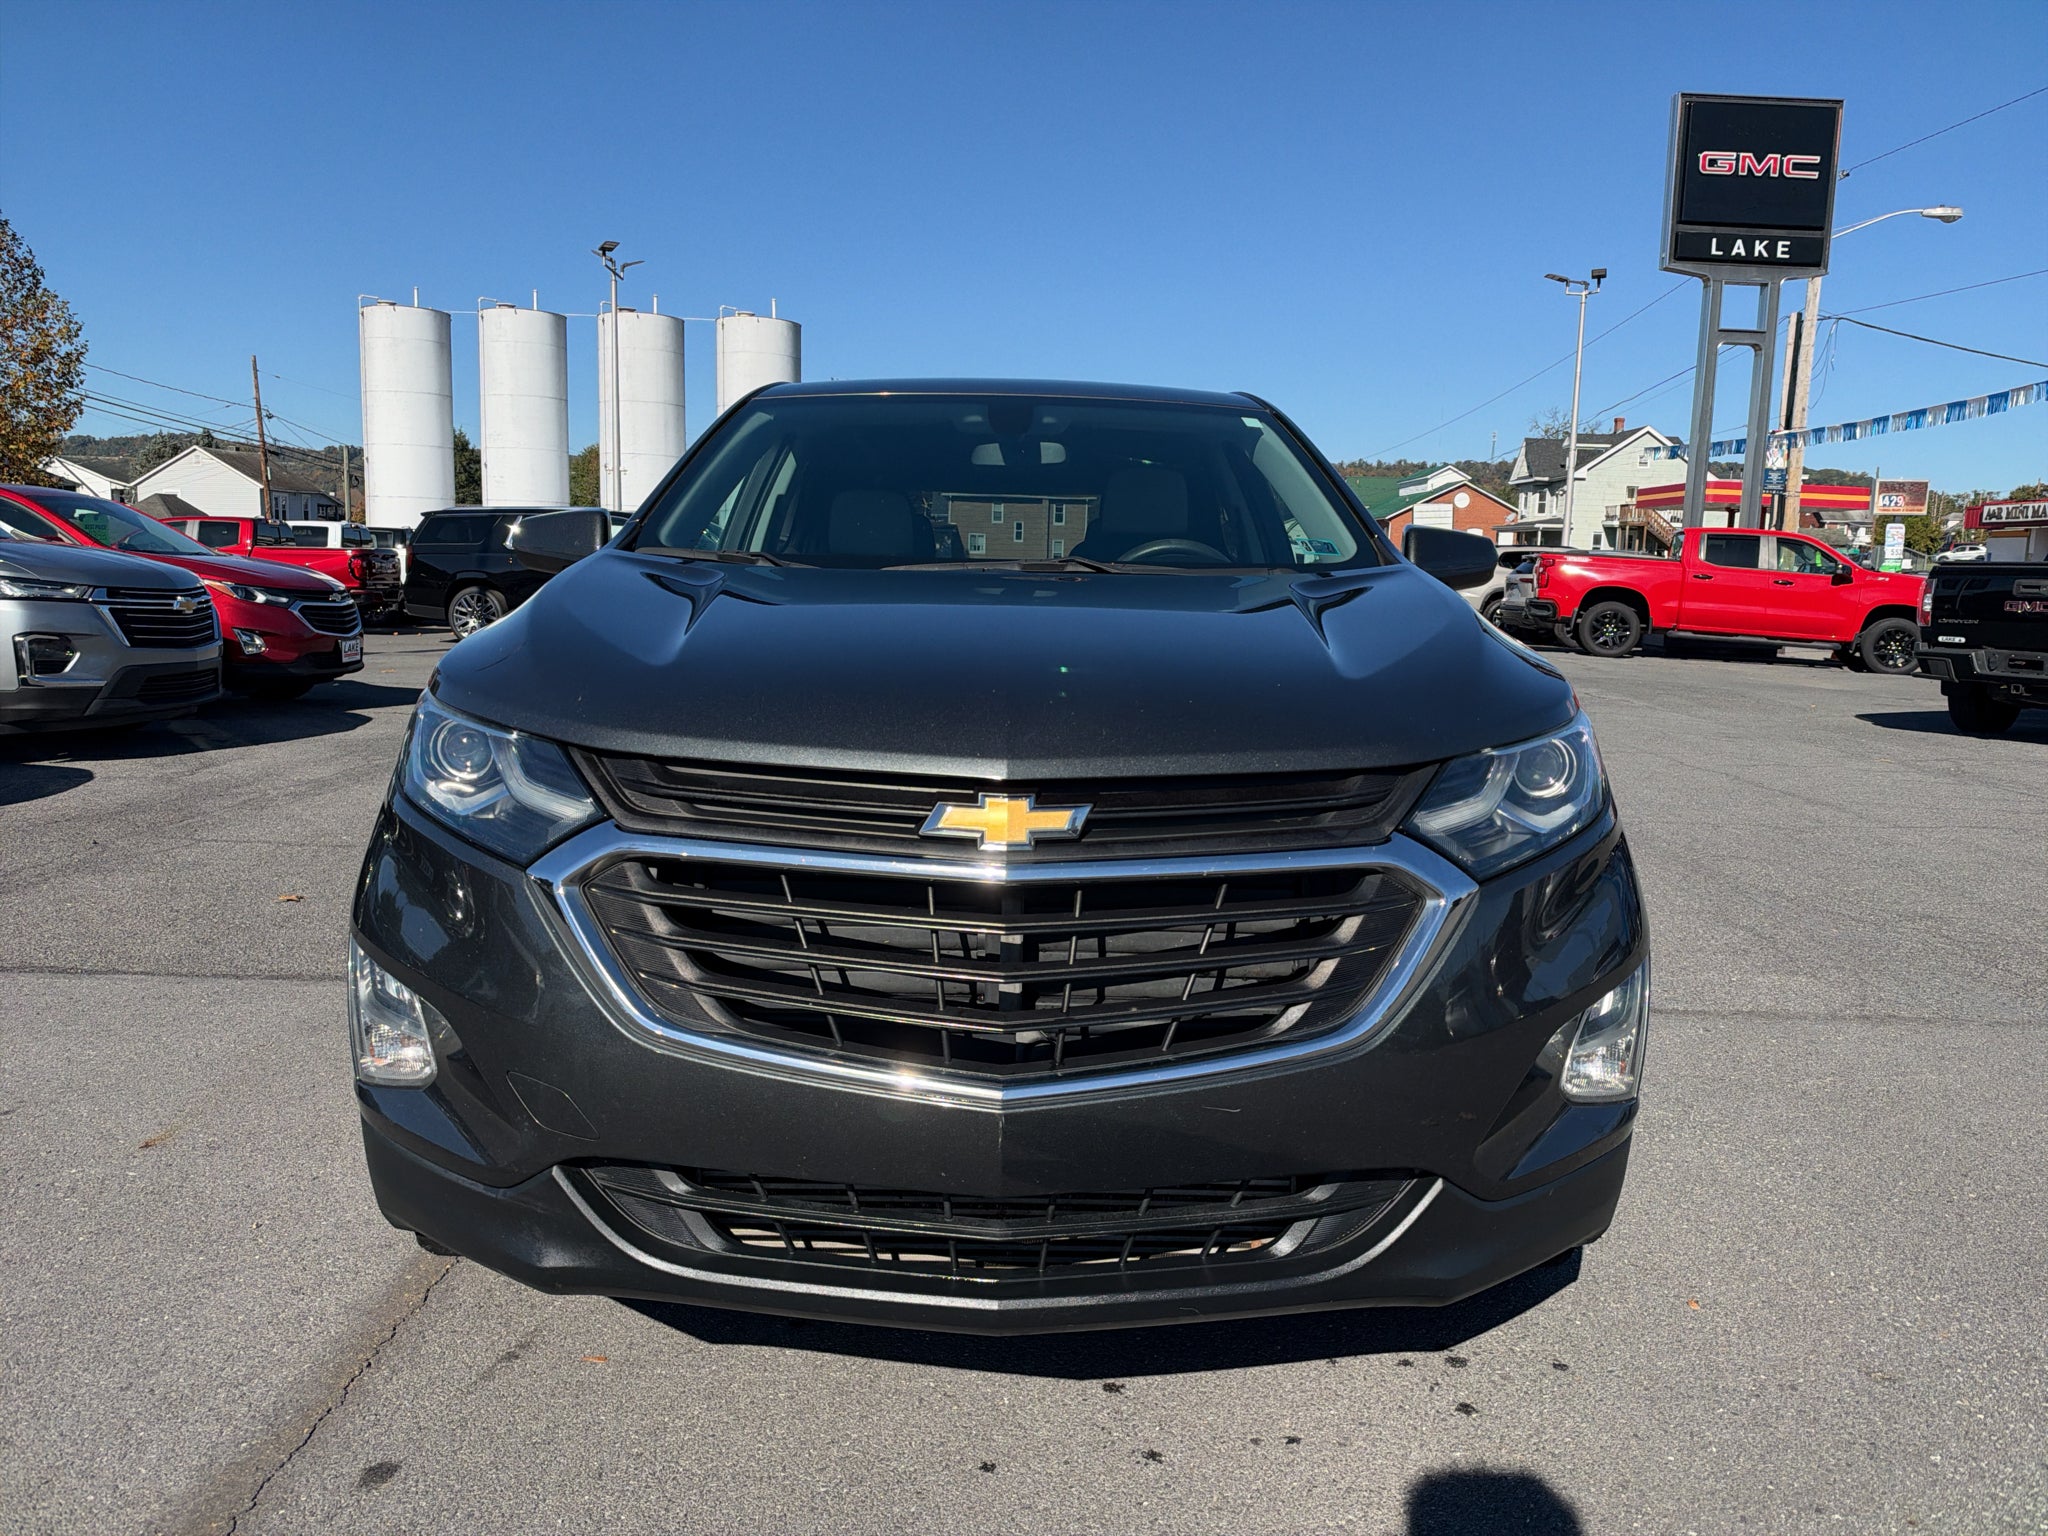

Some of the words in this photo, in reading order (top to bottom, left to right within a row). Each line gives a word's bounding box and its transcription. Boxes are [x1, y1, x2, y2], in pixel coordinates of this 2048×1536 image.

[1698, 150, 1821, 179] GMC
[1711, 237, 1791, 258] LAKE
[2005, 505, 2029, 519] MINI
